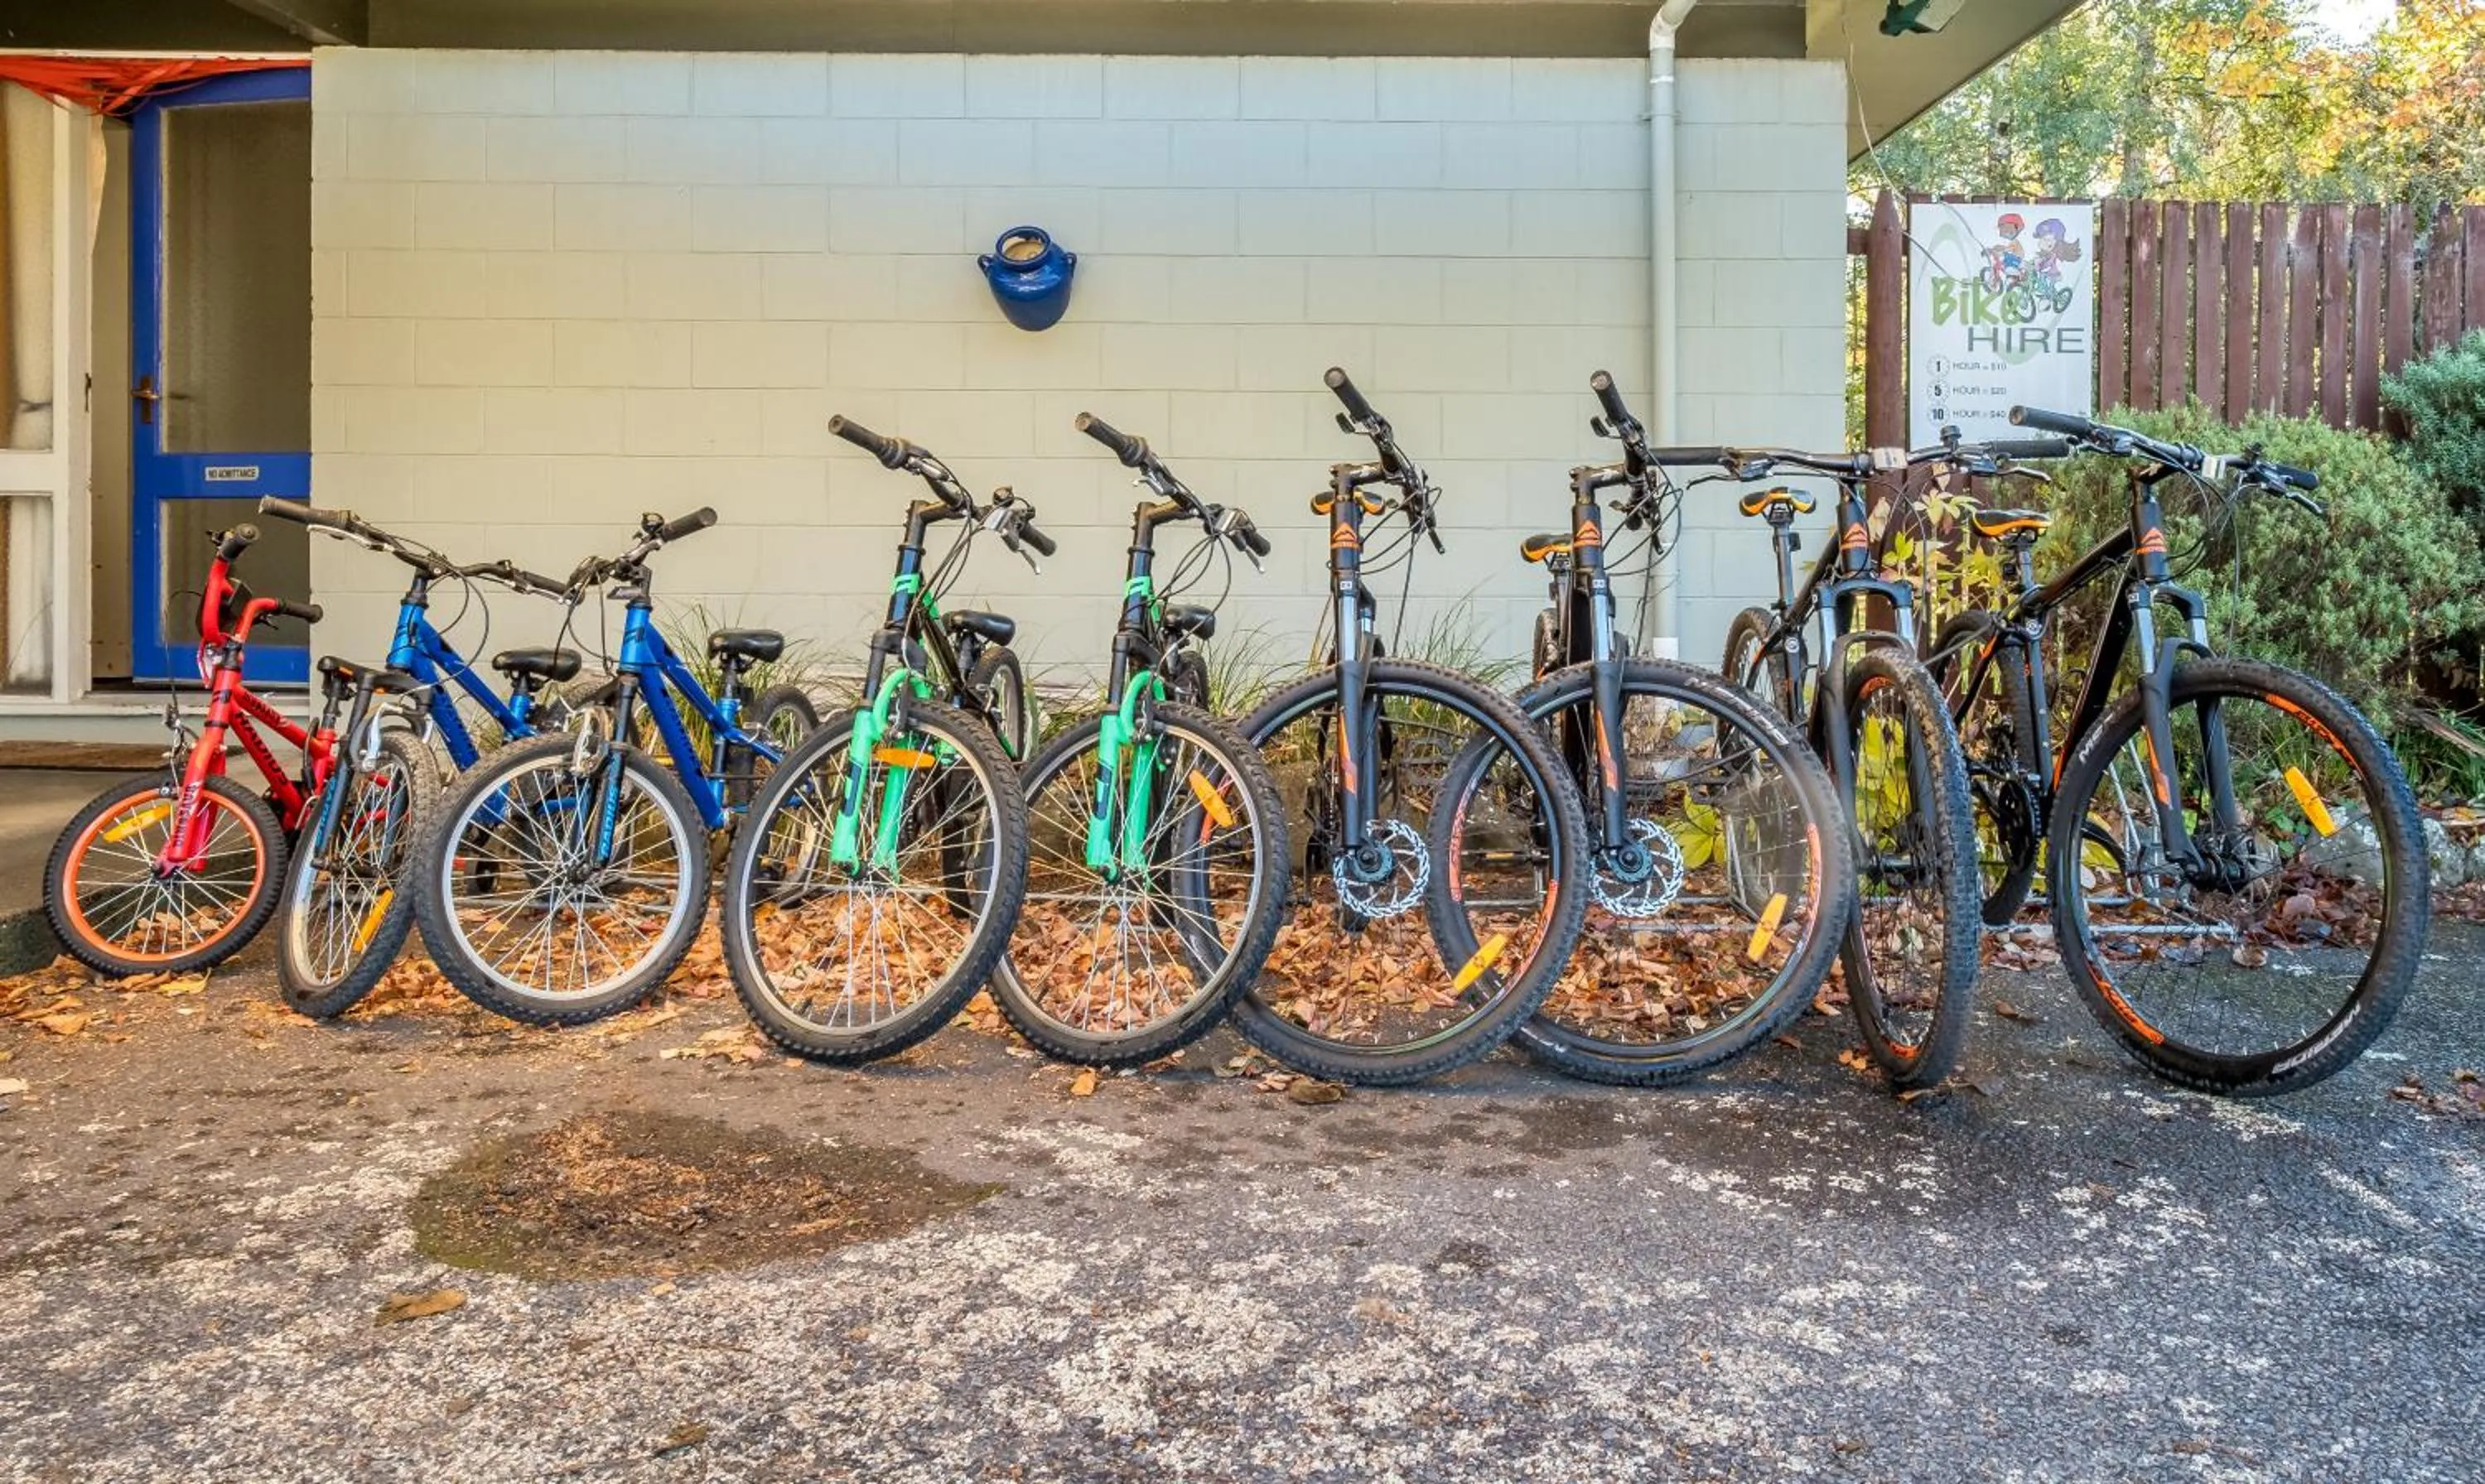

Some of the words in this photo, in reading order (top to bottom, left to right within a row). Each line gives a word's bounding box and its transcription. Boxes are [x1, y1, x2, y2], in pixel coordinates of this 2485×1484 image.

[1932, 276, 2024, 325] Bike
[1967, 327, 2085, 354] HIRE
[1936, 360, 1941, 372] 1
[1952, 362, 1981, 370] HOUR
[1990, 362, 2007, 371] $10
[1934, 385, 1942, 397] 5
[1952, 386, 1981, 395] HOUR
[1933, 408, 1944, 420] 10
[1952, 410, 1981, 418] HOUR
[208, 469, 218, 478] NO
[219, 469, 256, 478] ADMITTANCE
[234, 711, 288, 785] RADIUS
[601, 783, 620, 859] RADIUS
